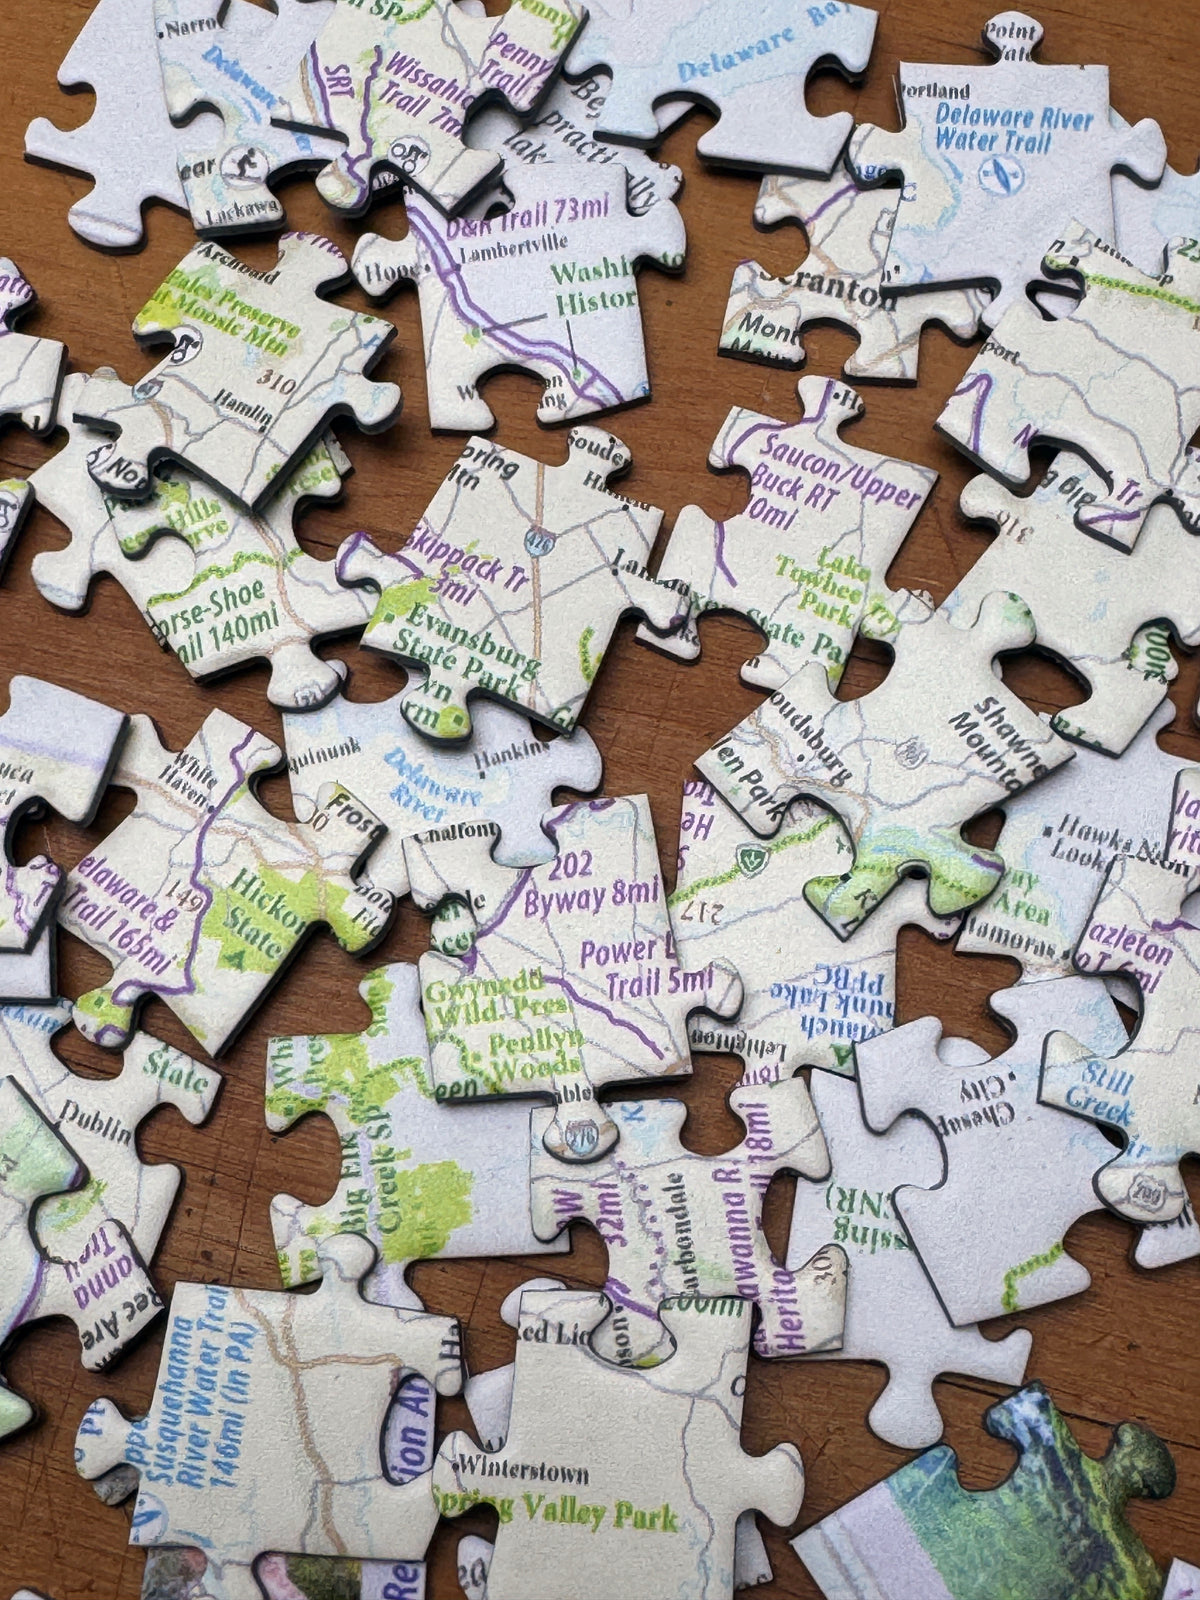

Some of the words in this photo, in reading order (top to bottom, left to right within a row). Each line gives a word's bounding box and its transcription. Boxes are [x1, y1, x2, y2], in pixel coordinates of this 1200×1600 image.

[490, 31, 554, 77] Penny
[677, 27, 794, 82] Delaware
[324, 64, 354, 100] SRT
[378, 80, 431, 117] Trail
[479, 58, 527, 97] Trail
[936, 102, 1034, 129] Delaware
[1041, 106, 1094, 132] River
[936, 126, 999, 153] Water
[1005, 130, 1052, 155] Trail
[555, 192, 610, 224] 73mi
[459, 233, 569, 263] Lambertville
[549, 255, 634, 285] Washi
[177, 292, 244, 335] Moosic
[242, 325, 288, 357] Mtn
[218, 287, 301, 340] Preserve
[556, 290, 637, 317] Histor
[256, 368, 297, 396] 310
[214, 388, 273, 433] Hamlin
[751, 463, 804, 501] Buck
[805, 484, 841, 512] RT
[760, 432, 924, 511] Saucon/Upper
[407, 525, 504, 583] Skippack
[503, 566, 530, 593] Tr
[776, 553, 863, 605] Towhee
[428, 571, 480, 606] 3mi
[797, 588, 854, 629] Park
[209, 601, 280, 652] 140mi
[406, 601, 542, 682] Evansburg
[746, 607, 806, 648] State
[393, 628, 458, 670] State
[462, 655, 526, 701] Park
[770, 690, 854, 787] oudsburg
[948, 712, 1025, 793] Mounta
[158, 764, 208, 806] Haven
[176, 751, 220, 791] White
[383, 746, 484, 807] Delaware
[739, 768, 788, 824] Park
[549, 850, 593, 881] 202
[78, 856, 159, 921] elaware
[155, 908, 179, 933] &
[166, 879, 204, 912] 149
[524, 885, 606, 920] Byway
[612, 874, 659, 907] 8mi
[61, 882, 118, 932] Trail
[108, 917, 178, 976] 165mi
[222, 906, 284, 959] State
[1088, 921, 1174, 968] azleton
[580, 939, 657, 969] Power
[425, 966, 544, 1003] Gwynedd
[607, 967, 659, 1001] Trail
[668, 961, 715, 994] 5mi
[513, 994, 570, 1020] Pres
[489, 1027, 585, 1056] Penllyn
[143, 1052, 209, 1094] State
[489, 1048, 582, 1083] Woods
[1081, 1059, 1135, 1097] Still
[960, 1073, 1006, 1103] City
[1065, 1085, 1136, 1127] Creek
[59, 1099, 133, 1146] Dublin
[738, 1101, 774, 1164] 18mi
[368, 1145, 403, 1234] Creek
[225, 1321, 259, 1364] PA)
[184, 1338, 222, 1416] Water
[219, 1369, 252, 1404] (in
[145, 1315, 193, 1487] Susquehanna
[176, 1421, 212, 1488] River
[209, 1409, 245, 1487] 146mi
[457, 1454, 590, 1486] Winterstown
[523, 1491, 607, 1534] Valley
[613, 1499, 678, 1534] Park
